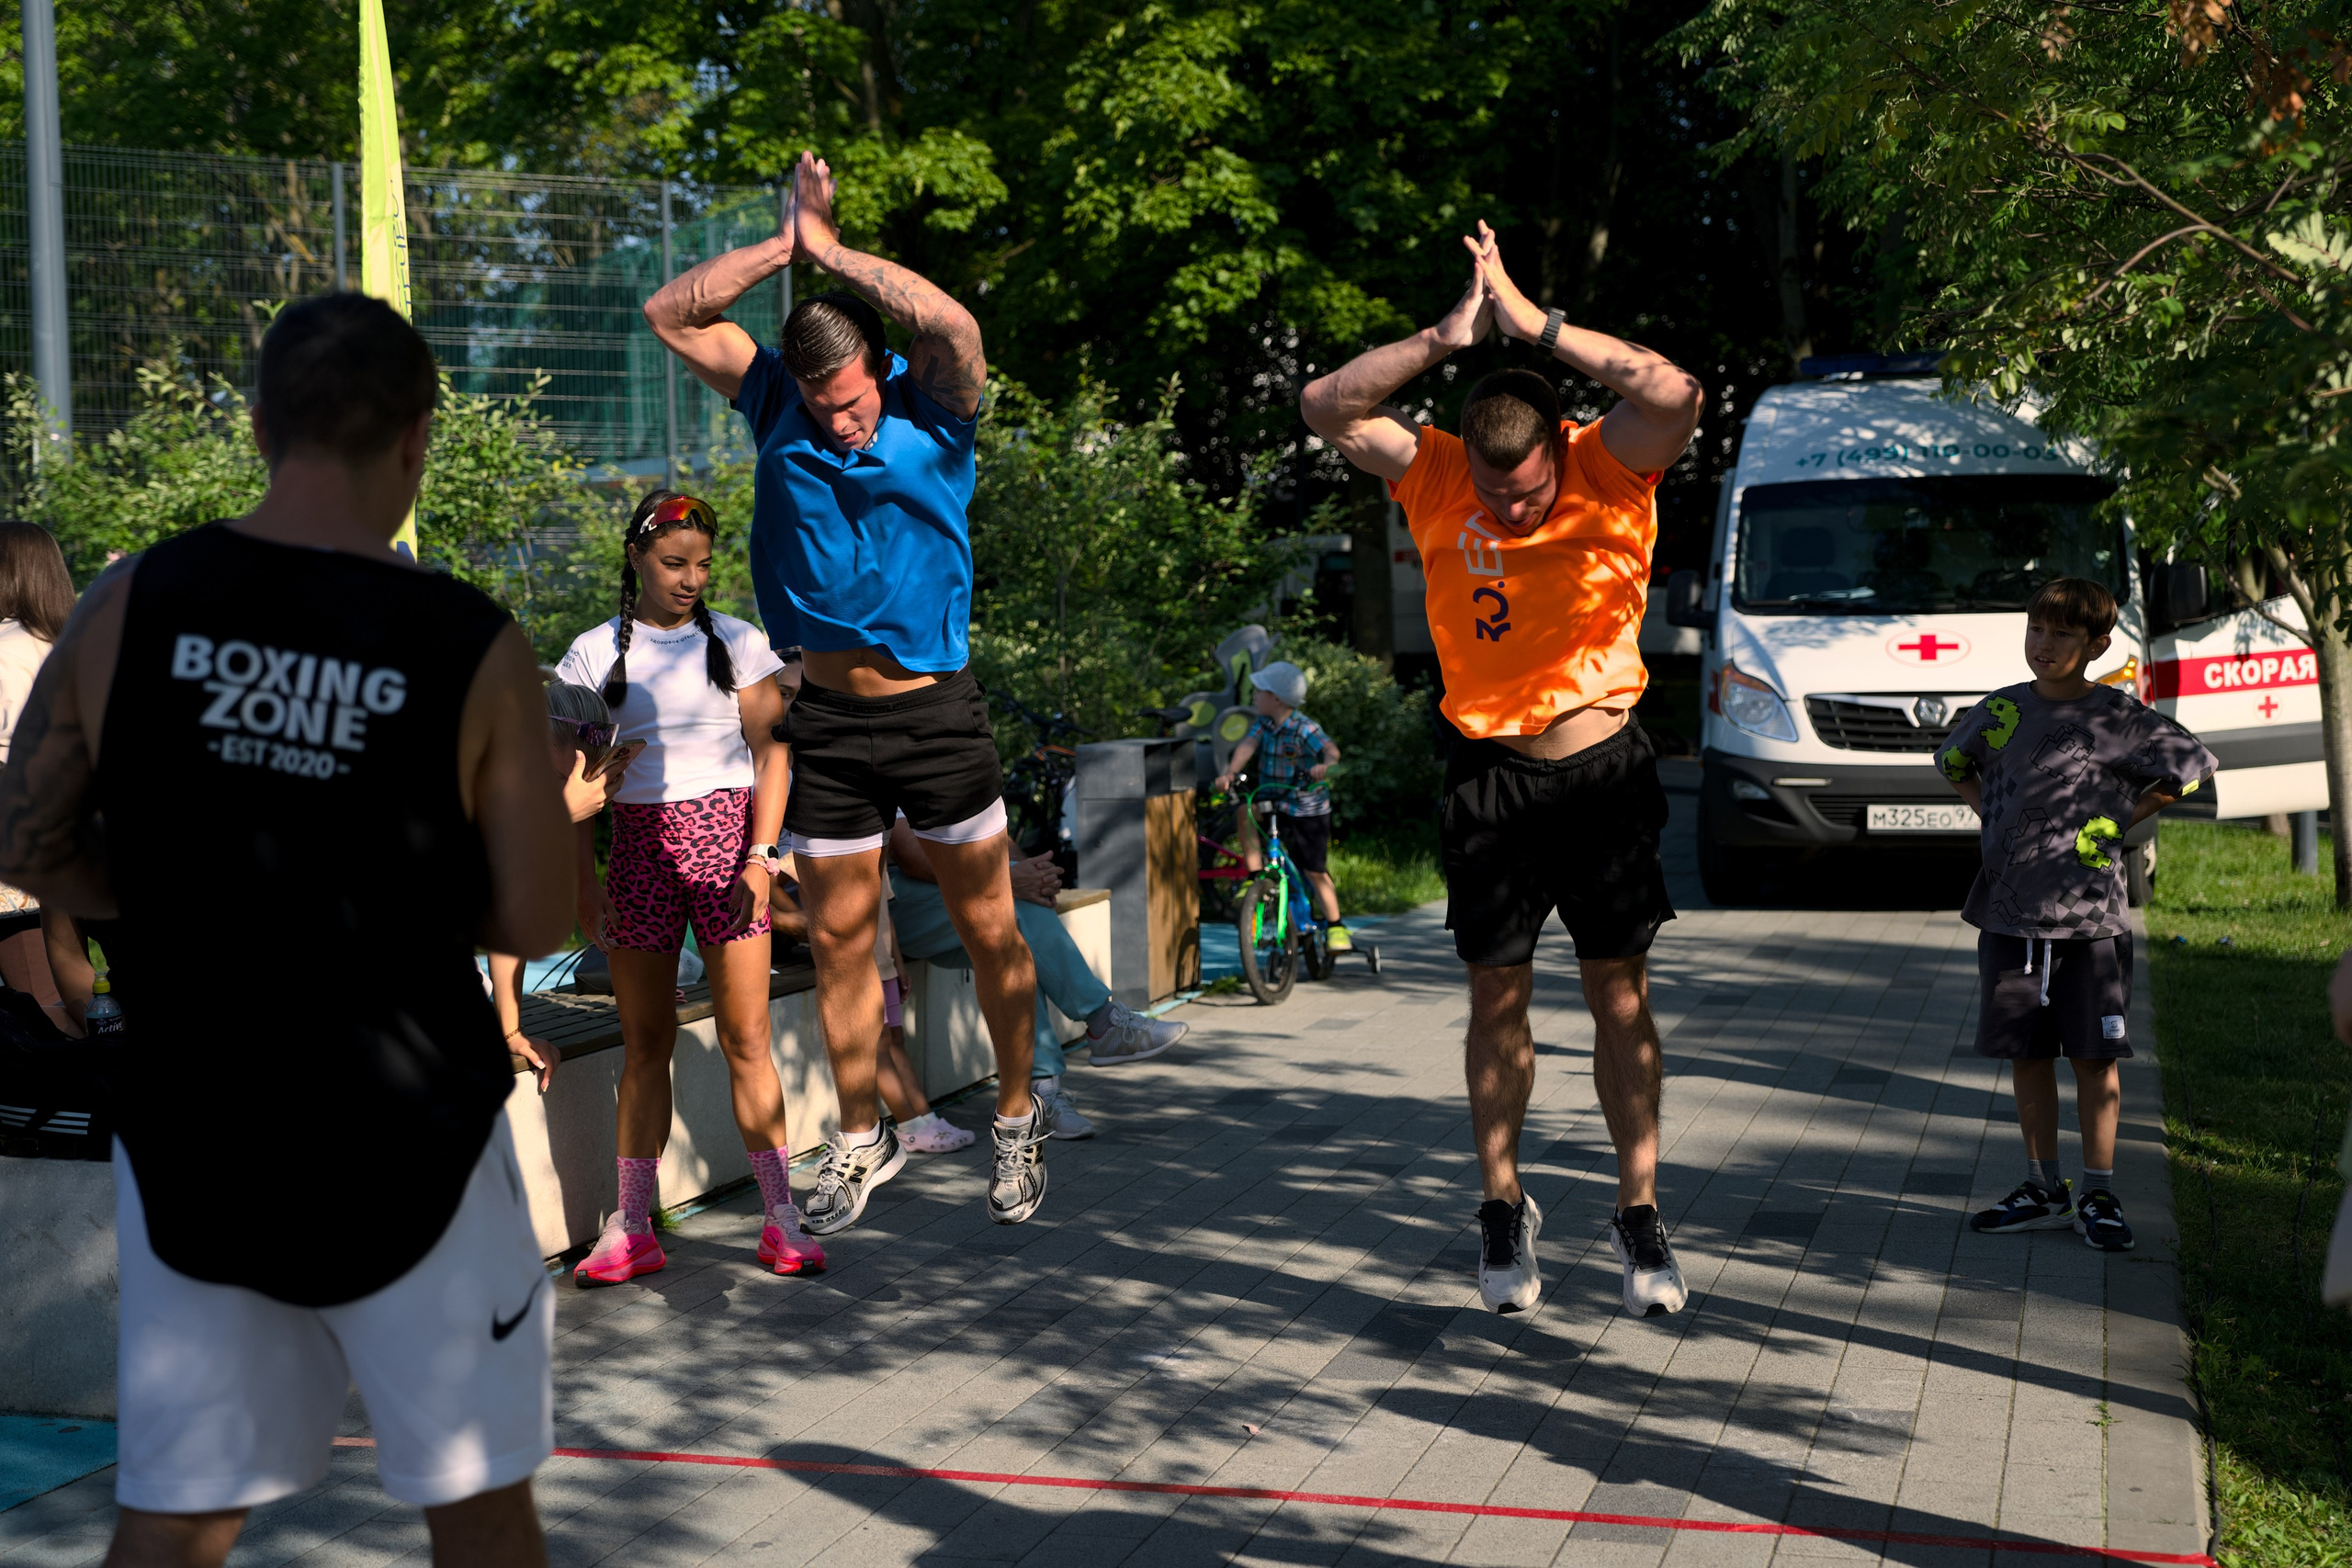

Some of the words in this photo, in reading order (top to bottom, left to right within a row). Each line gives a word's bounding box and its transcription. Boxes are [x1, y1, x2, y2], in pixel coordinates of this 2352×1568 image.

[1796, 453, 1826, 468] +7
[171, 633, 408, 716] BOXING
[2204, 653, 2318, 689] СКОРАЯ
[199, 679, 369, 751] ZONE
